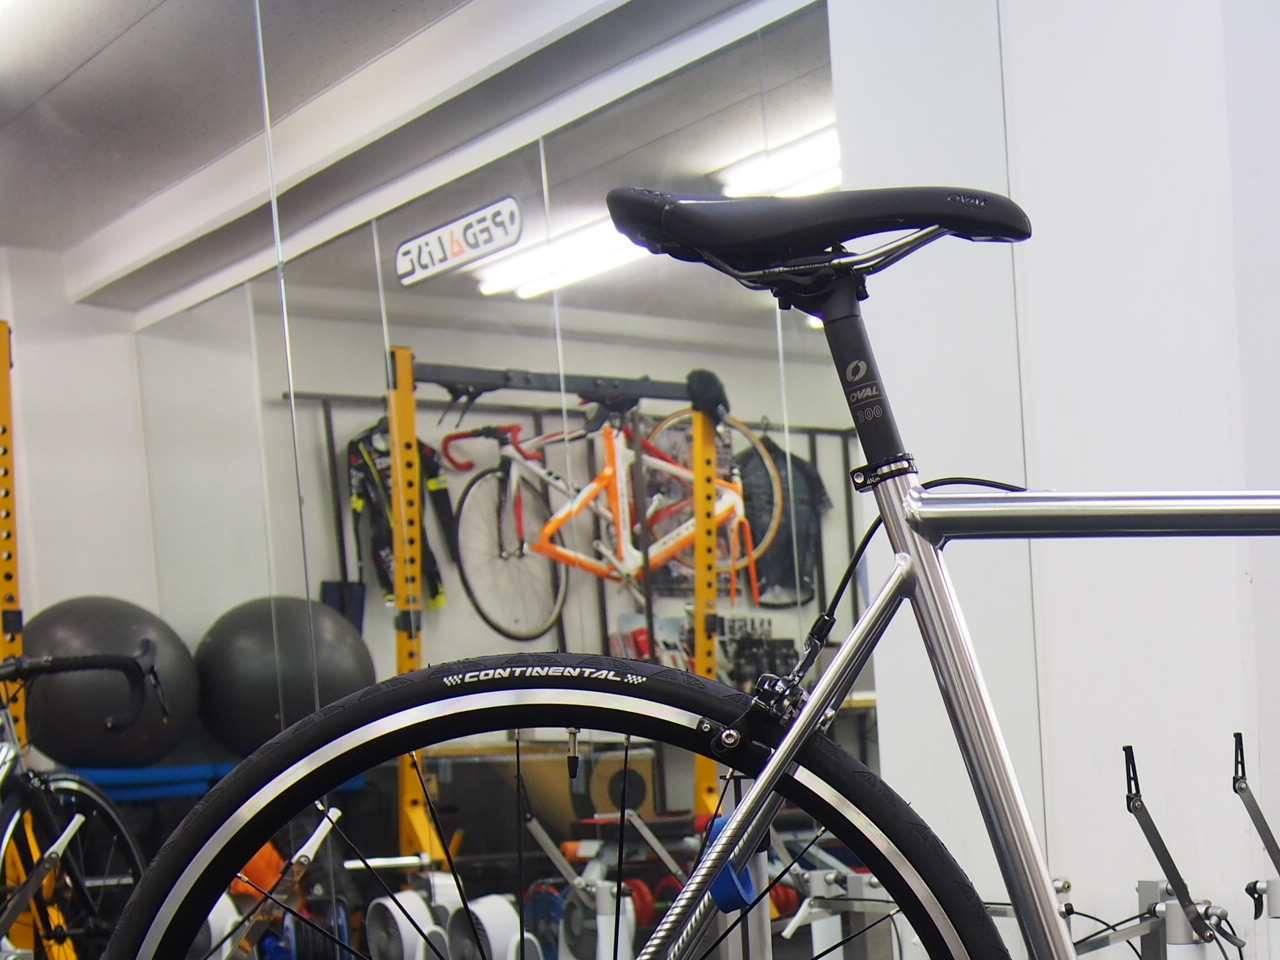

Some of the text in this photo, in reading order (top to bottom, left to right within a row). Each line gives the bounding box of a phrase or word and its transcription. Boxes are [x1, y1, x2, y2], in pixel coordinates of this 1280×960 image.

[849, 385, 879, 403] OVAL
[857, 405, 883, 424] 300
[464, 666, 622, 683] CONTINENTAL
